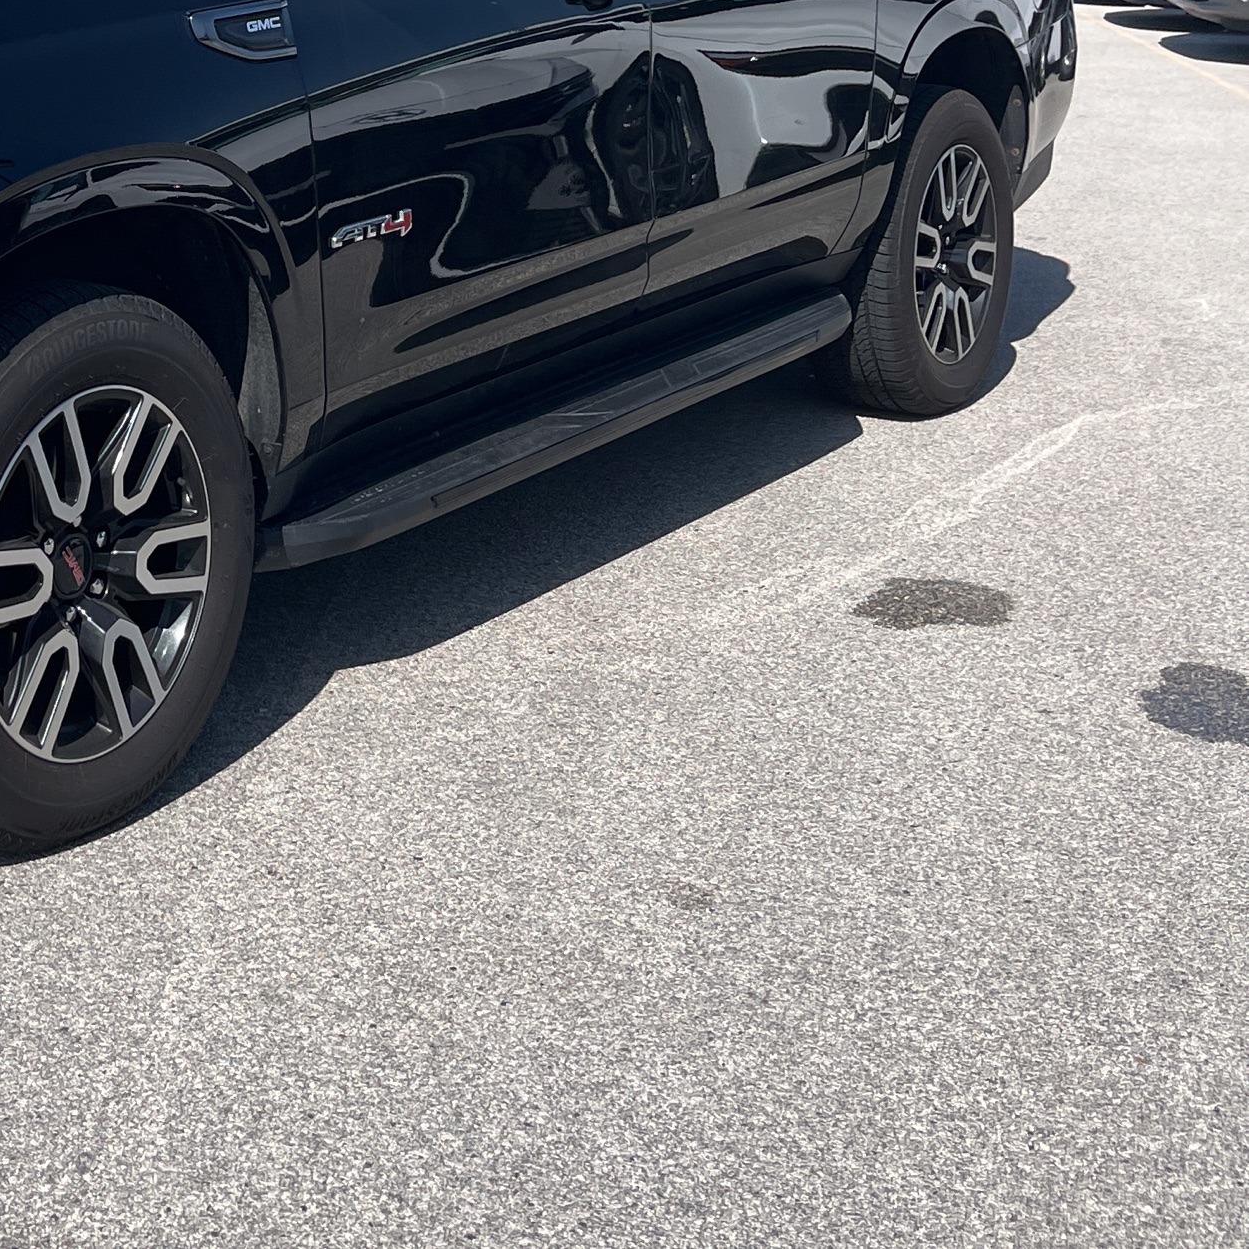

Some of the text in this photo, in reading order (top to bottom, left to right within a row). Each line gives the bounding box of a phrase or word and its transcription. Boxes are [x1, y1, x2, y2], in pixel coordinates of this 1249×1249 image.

[246, 16, 281, 32] GMC
[331, 208, 412, 248] AT4
[61, 545, 86, 587] GMC
